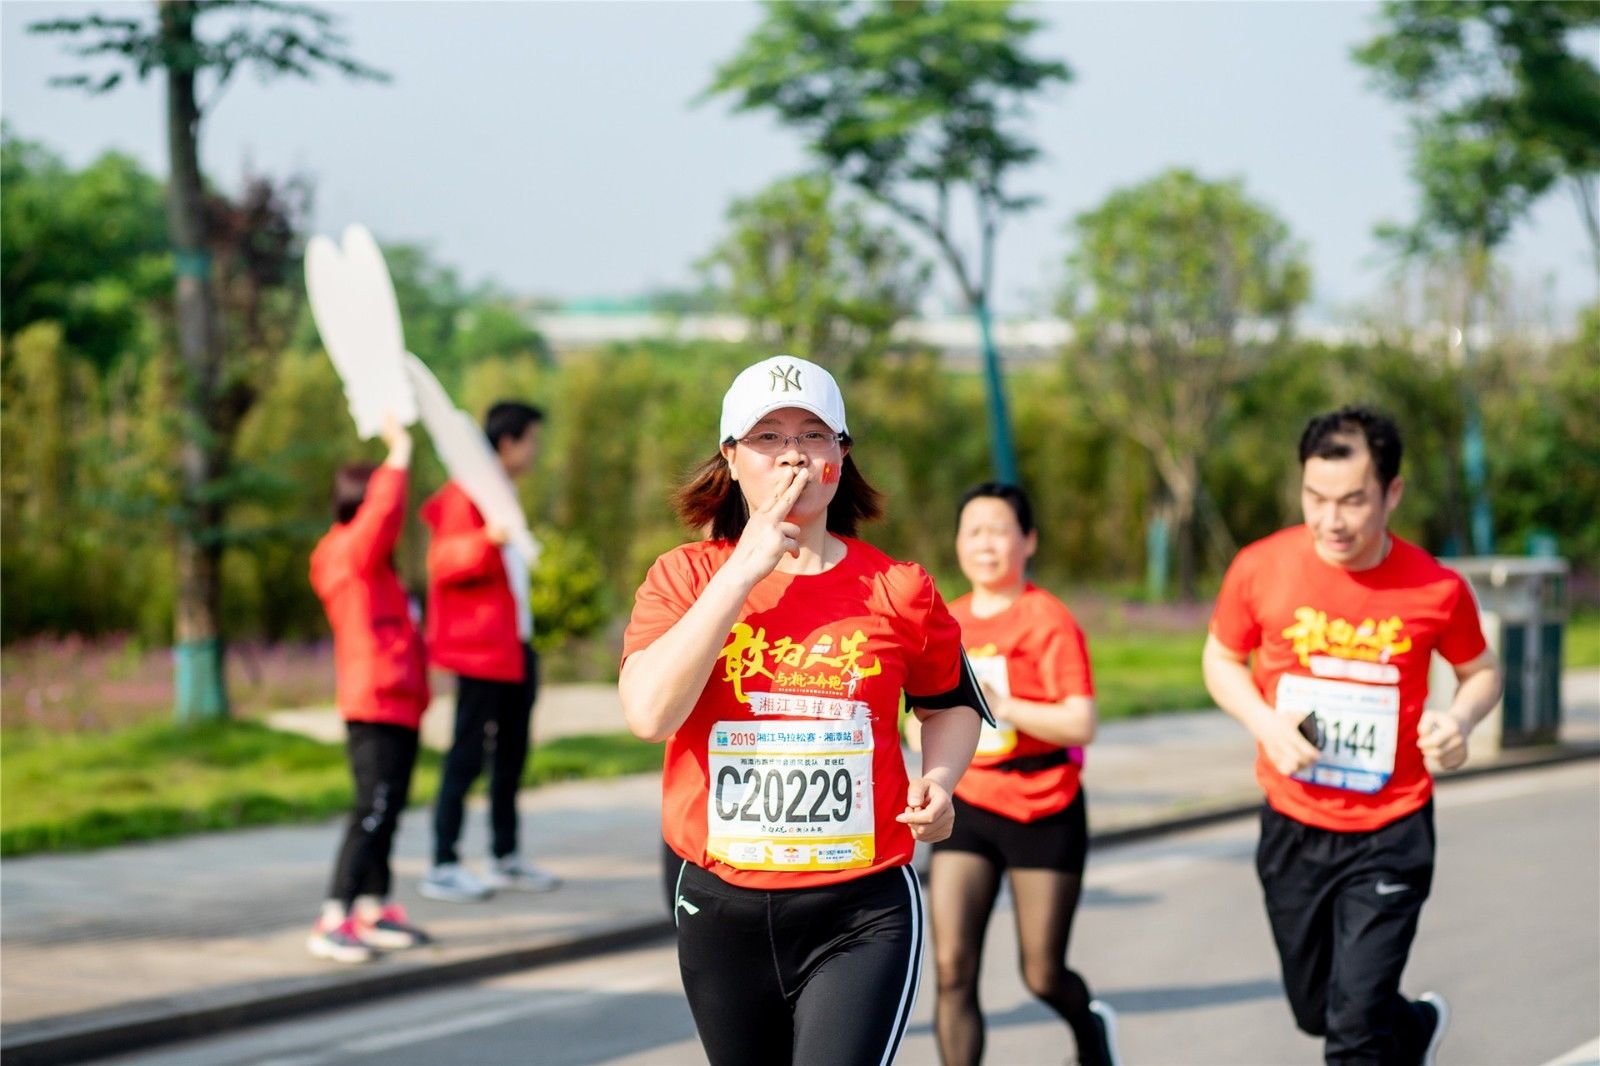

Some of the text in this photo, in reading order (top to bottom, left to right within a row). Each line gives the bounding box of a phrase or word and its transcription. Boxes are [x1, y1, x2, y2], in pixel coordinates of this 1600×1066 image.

[759, 697, 857, 717] 湘江马拉松赛
[730, 733, 756, 746] 2019
[716, 765, 853, 823] C20229
